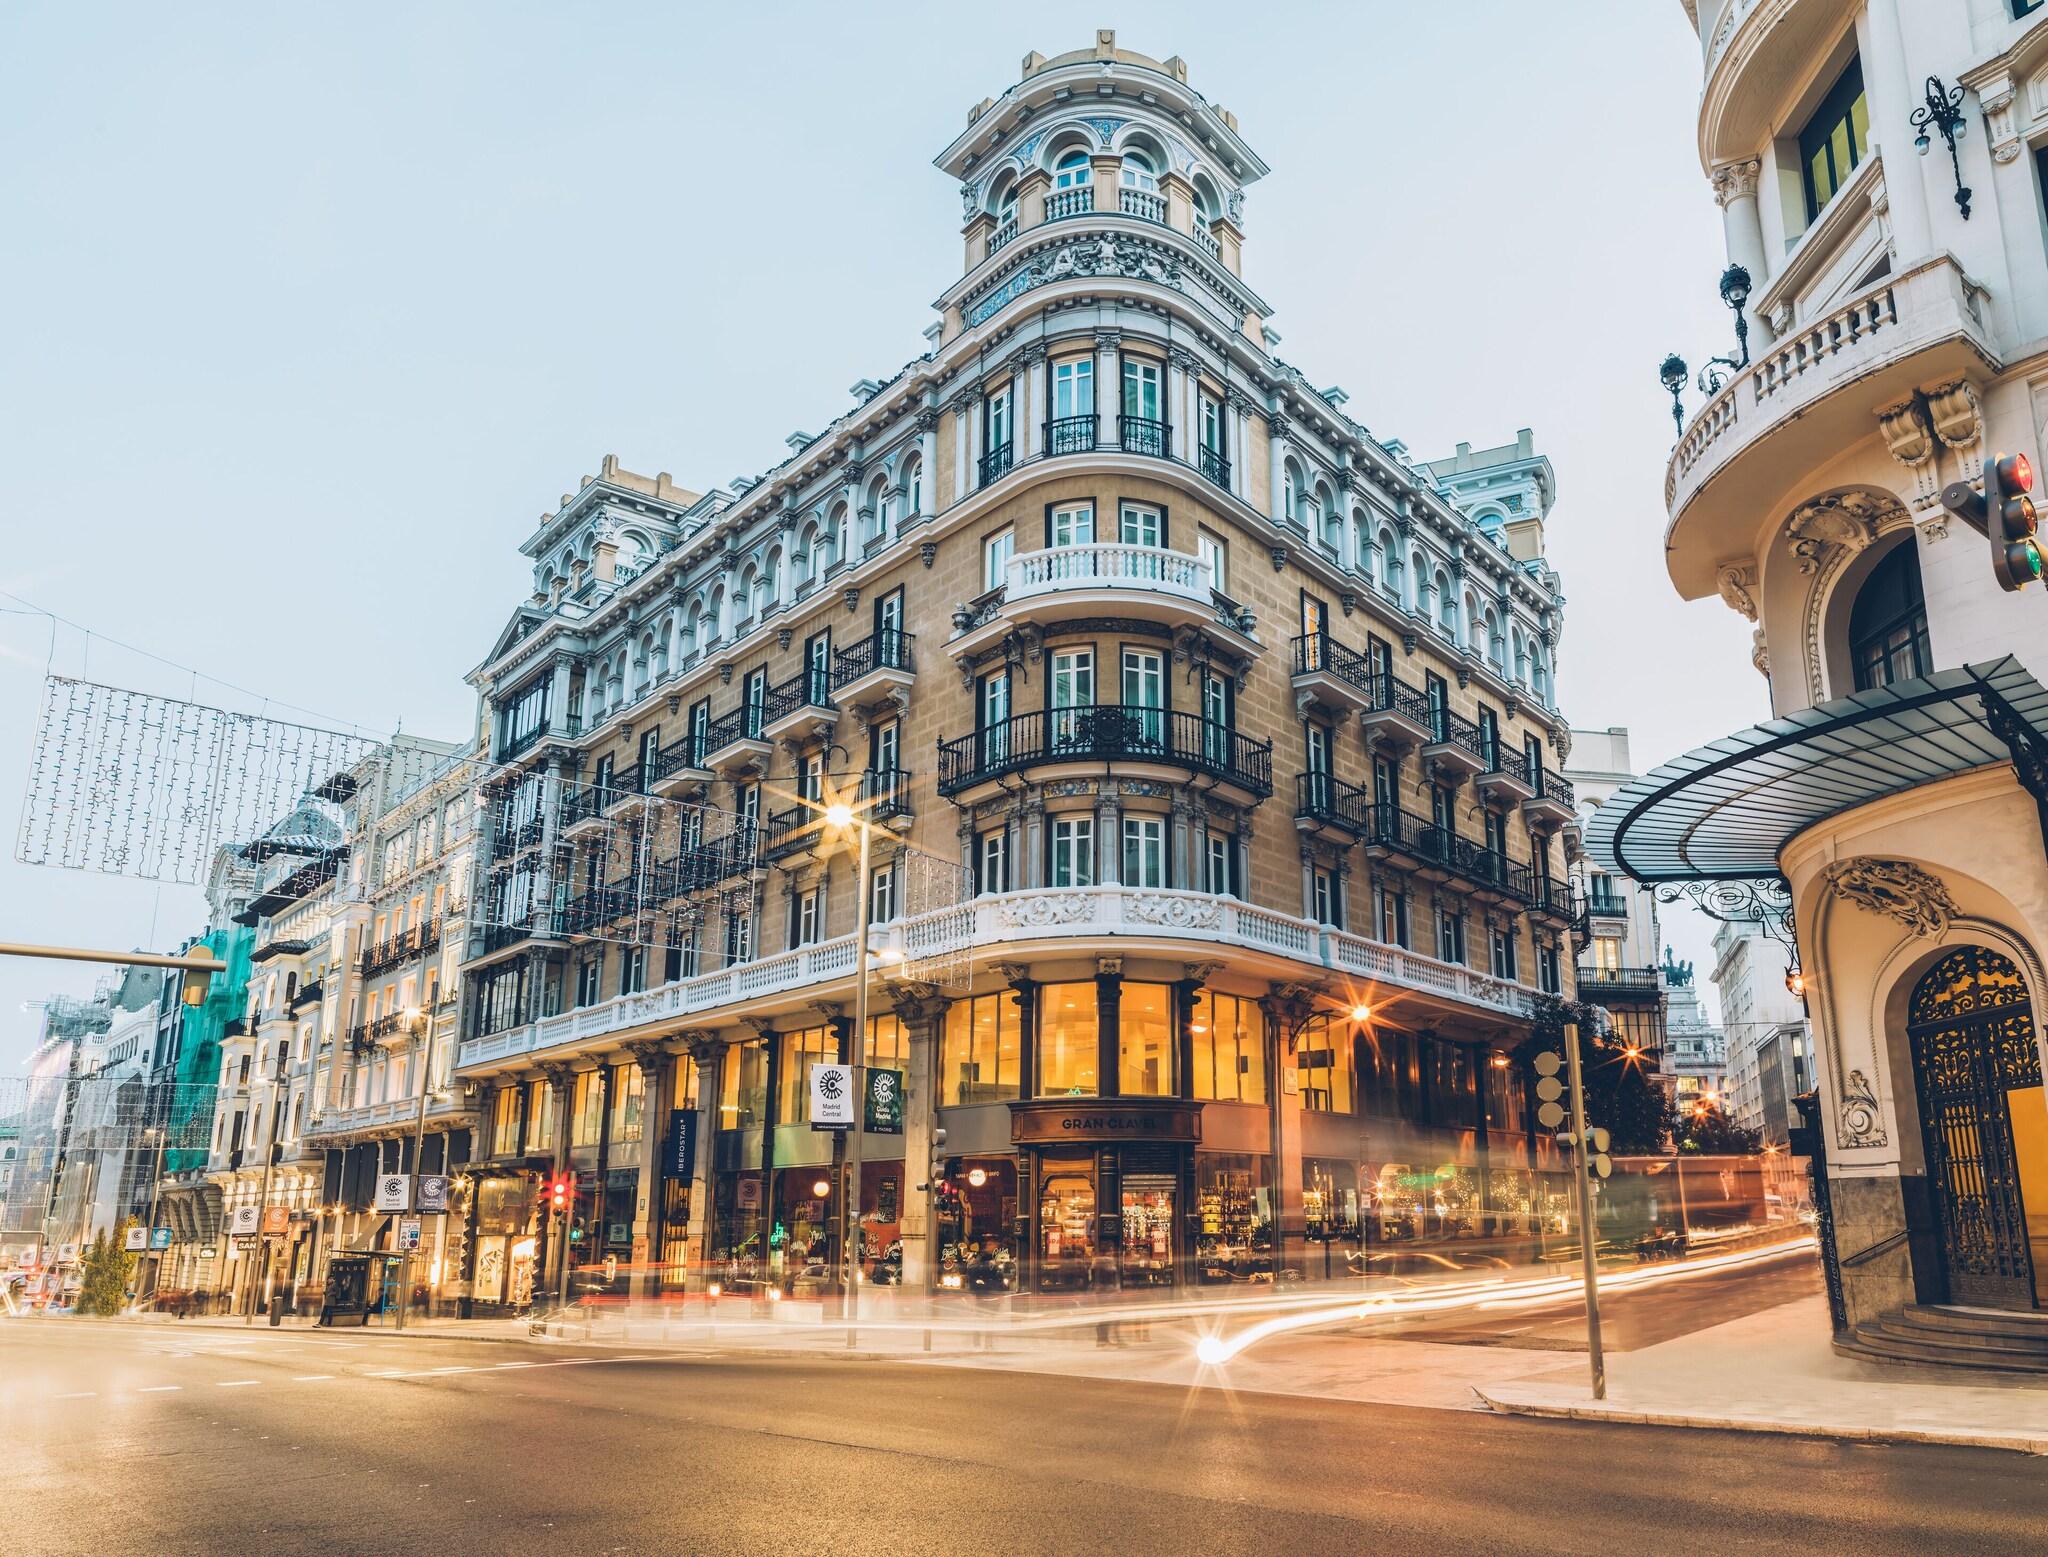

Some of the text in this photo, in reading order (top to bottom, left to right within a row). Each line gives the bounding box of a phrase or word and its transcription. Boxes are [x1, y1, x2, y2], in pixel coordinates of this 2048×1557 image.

[1062, 1118, 1157, 1129] GRAN CLAVEL
[677, 1124, 687, 1172] IBEROSTAR
